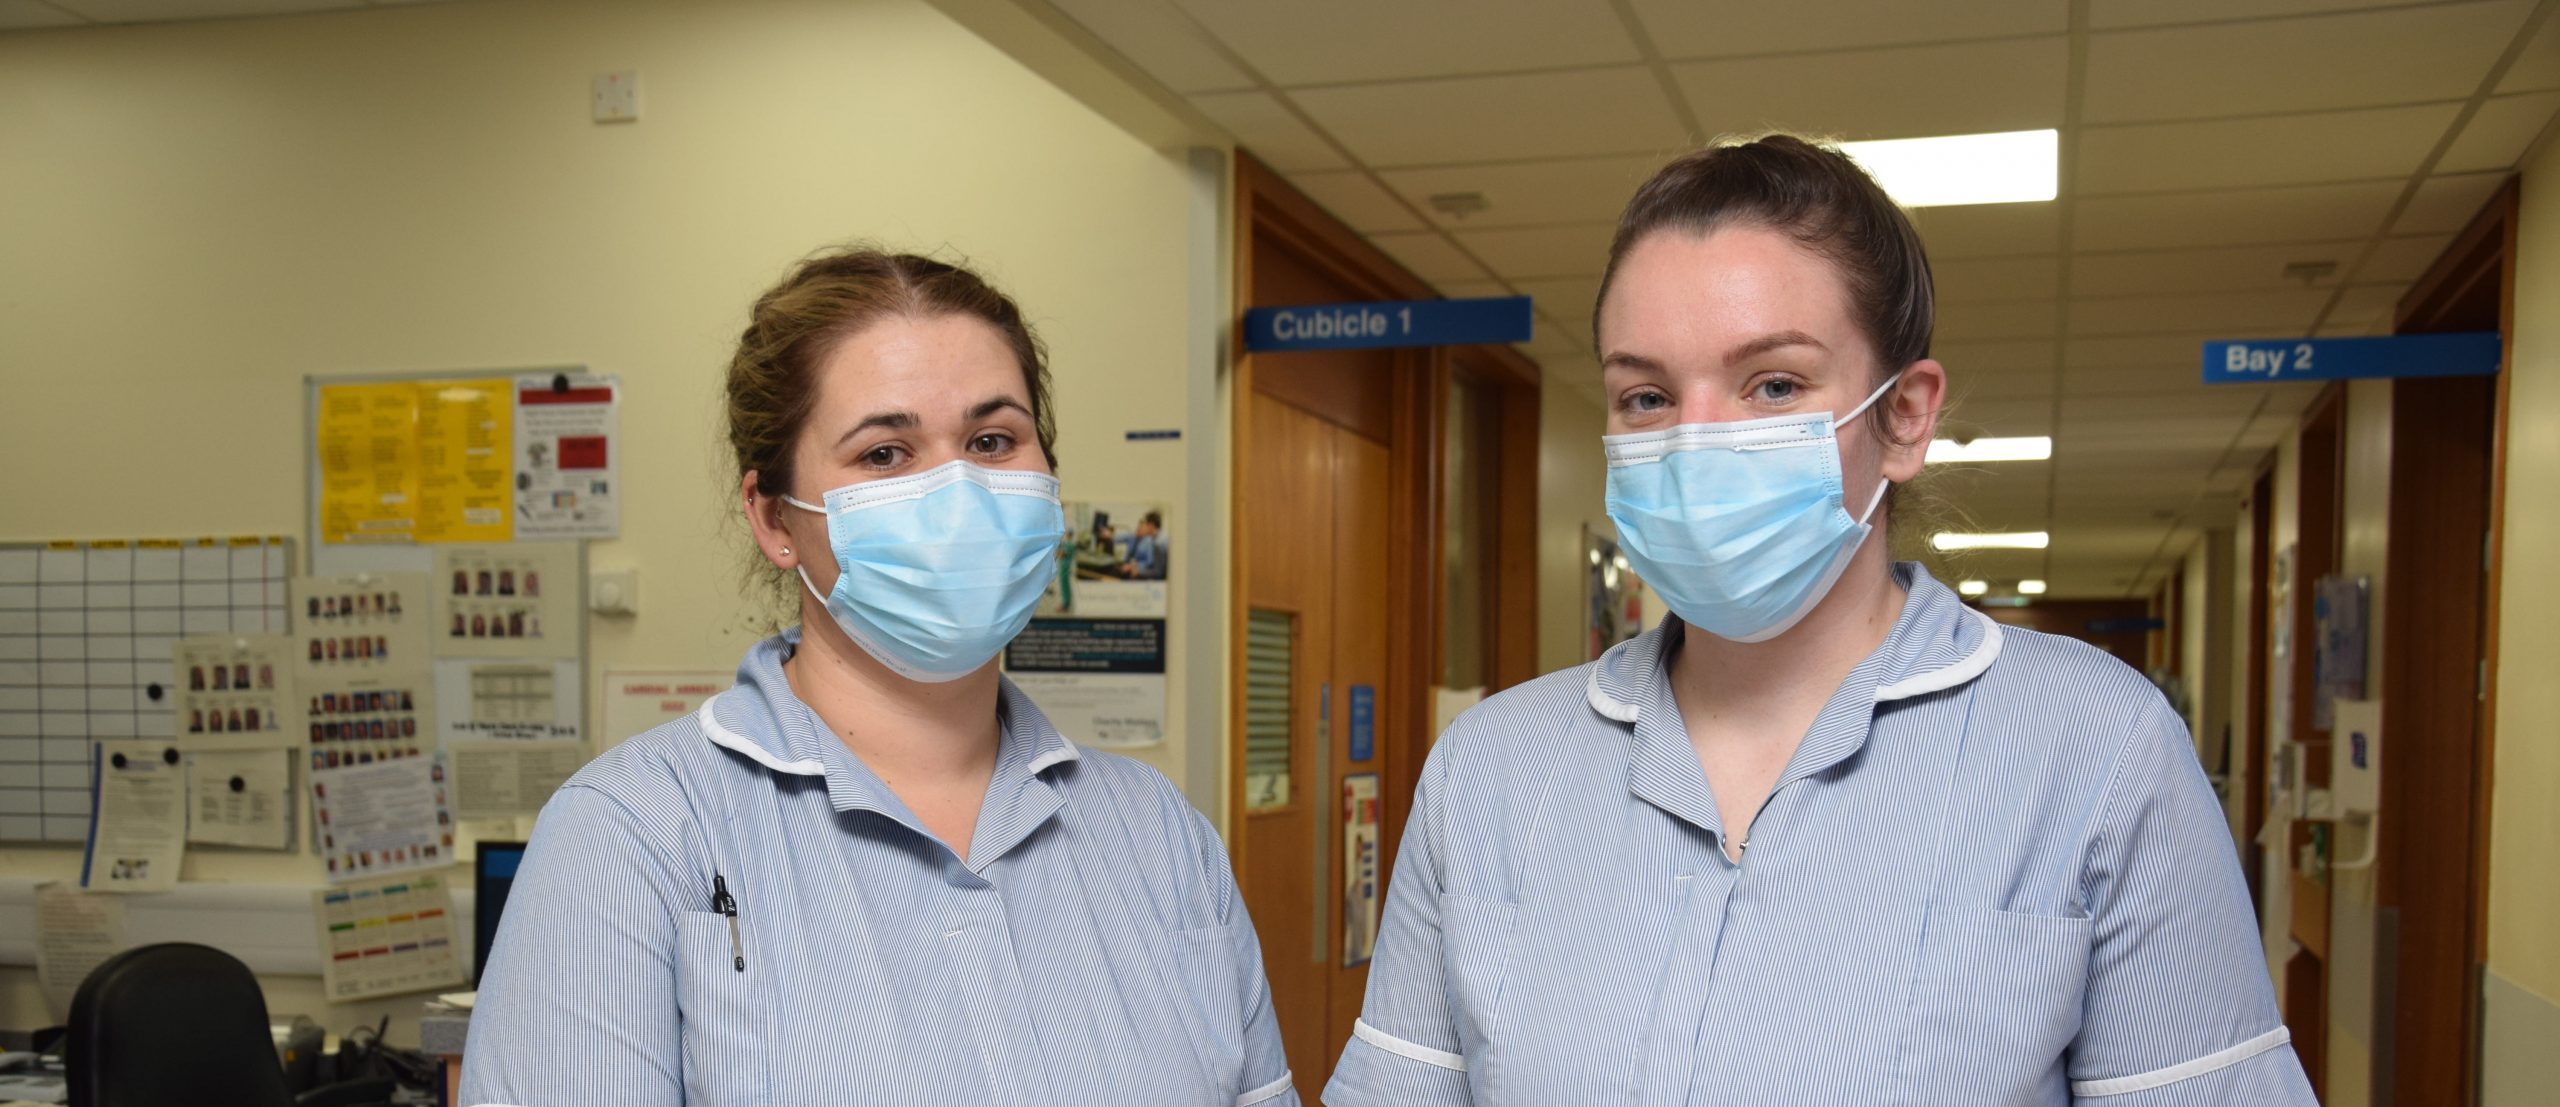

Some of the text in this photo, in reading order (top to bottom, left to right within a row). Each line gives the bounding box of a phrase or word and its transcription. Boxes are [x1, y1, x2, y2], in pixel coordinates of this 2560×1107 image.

[1273, 308, 1411, 340] Cubicle 1
[2226, 343, 2313, 377] Bay 2
